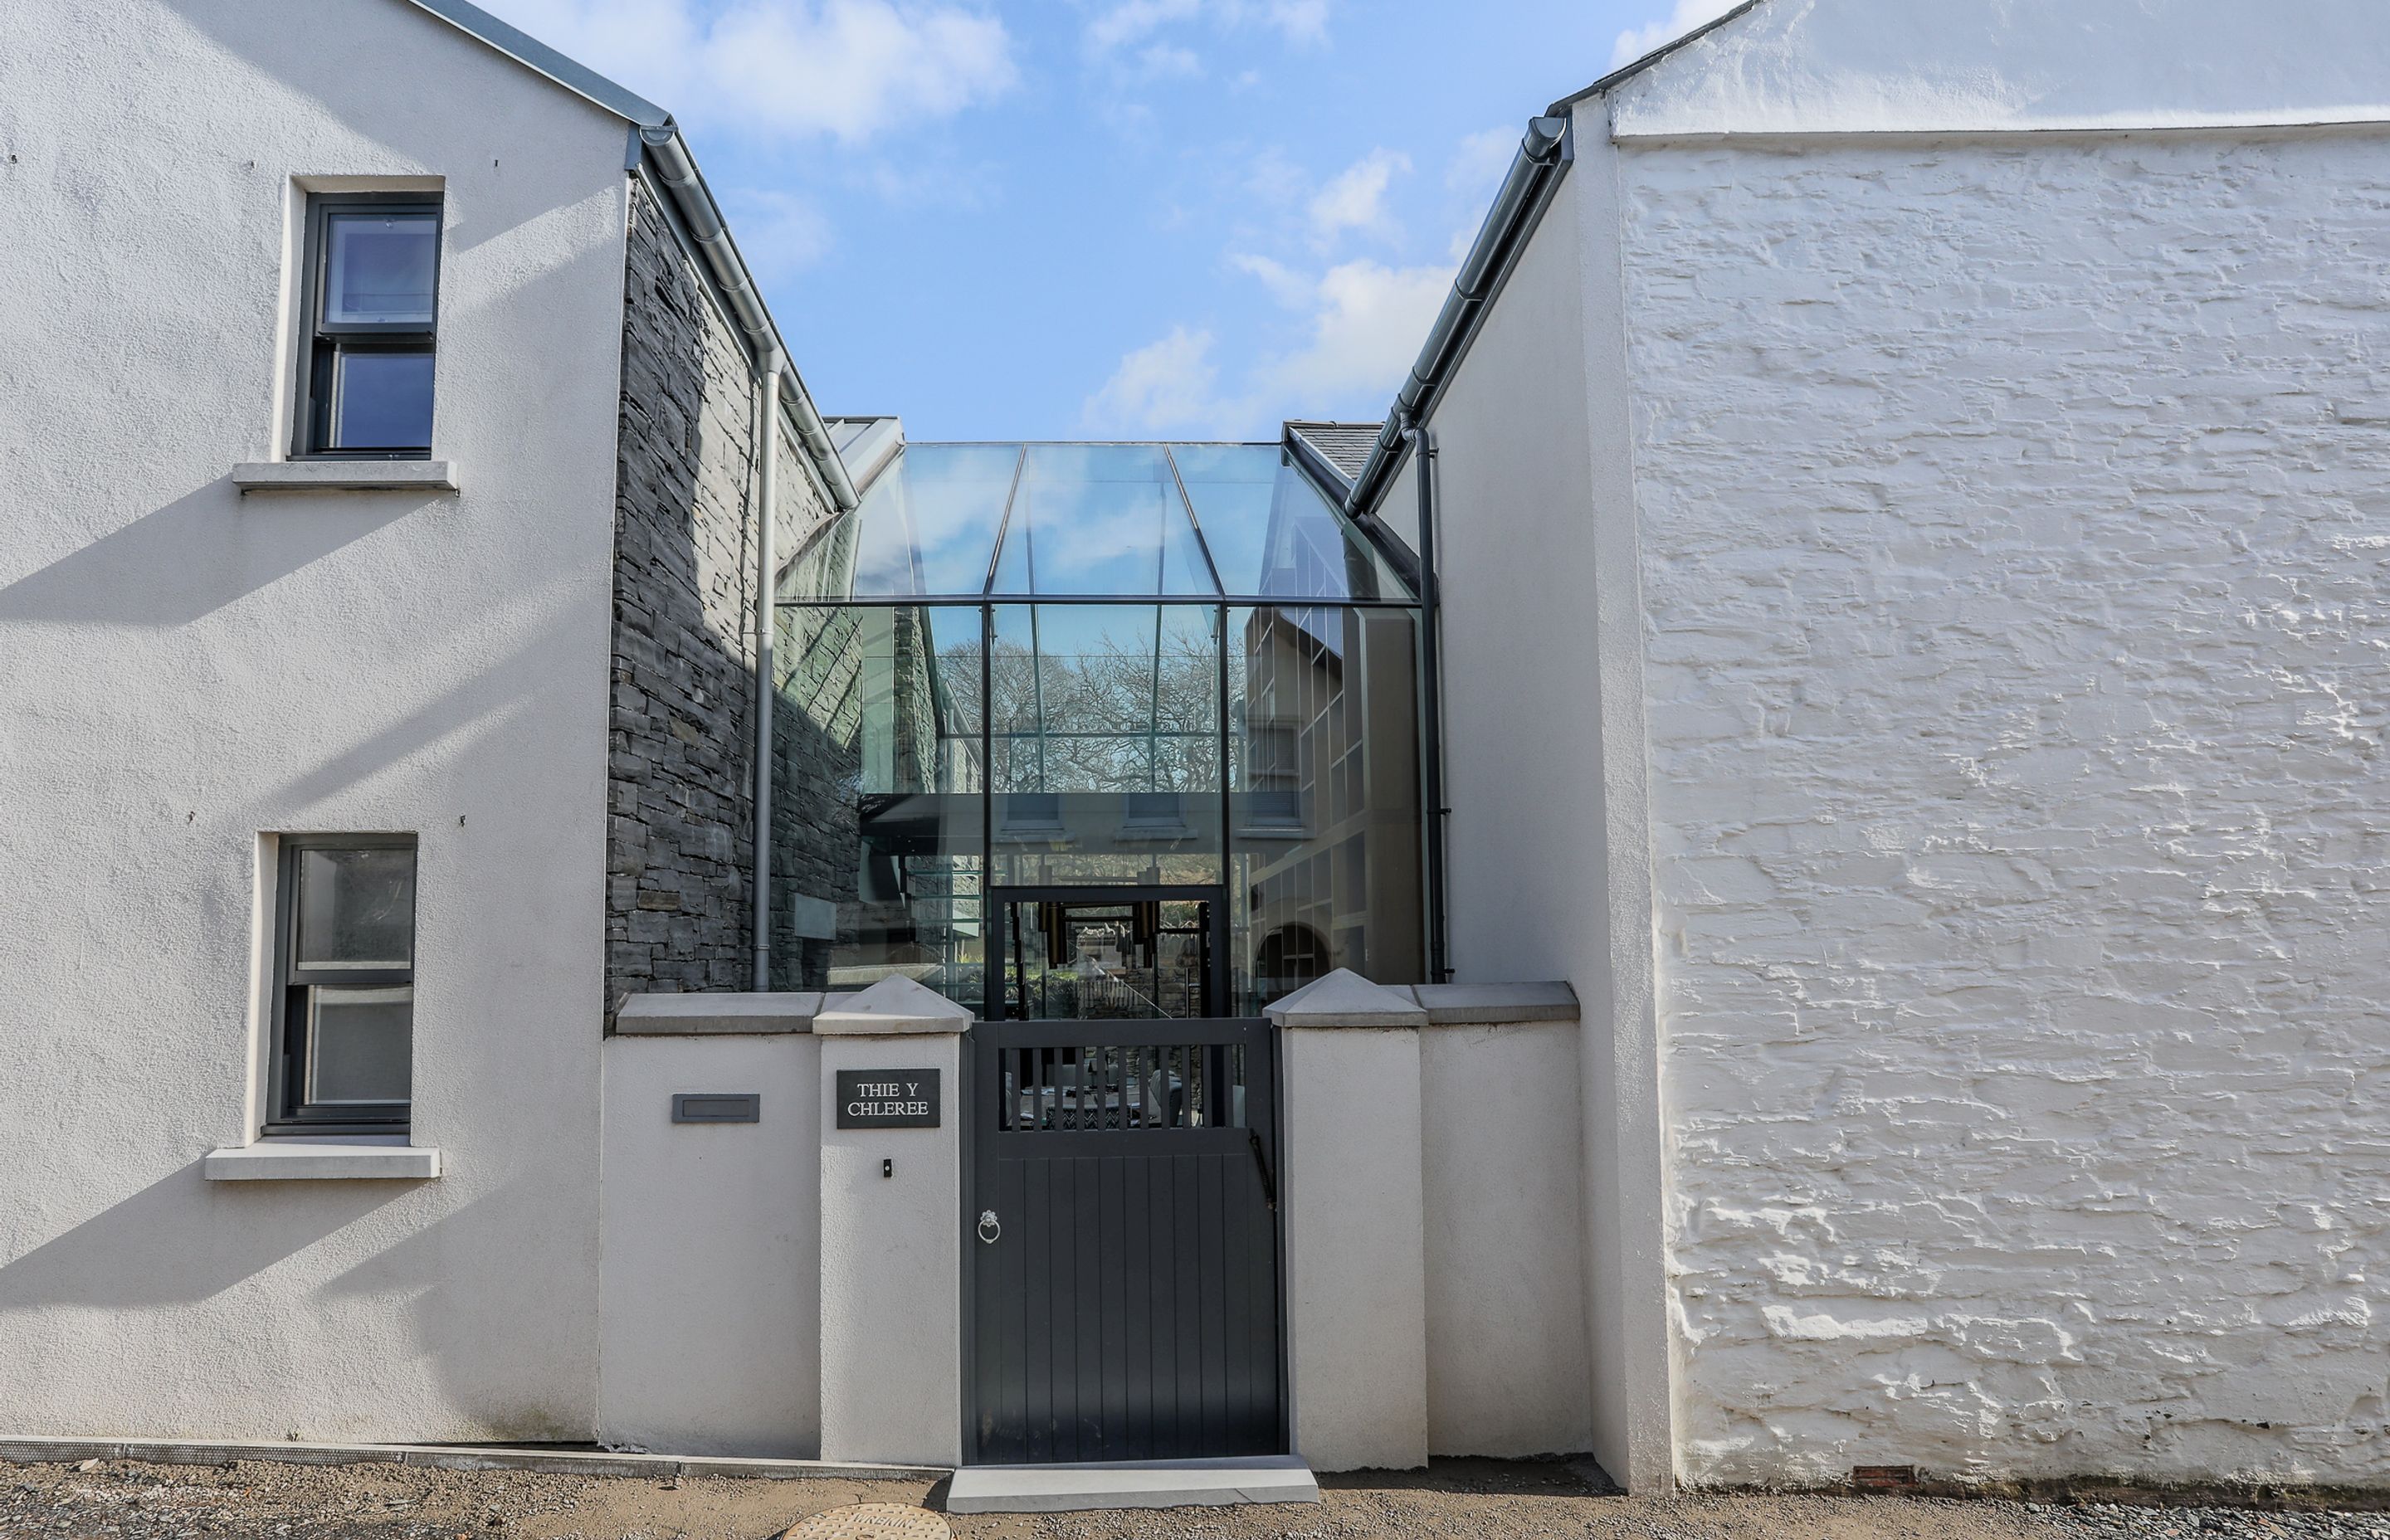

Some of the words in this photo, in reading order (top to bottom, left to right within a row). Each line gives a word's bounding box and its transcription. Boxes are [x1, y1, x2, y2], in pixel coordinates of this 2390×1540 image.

[857, 1083, 900, 1097] THIE
[906, 1083, 918, 1096] Y
[847, 1101, 928, 1116] CHLEREE
[853, 1513, 911, 1528] WREKIN
